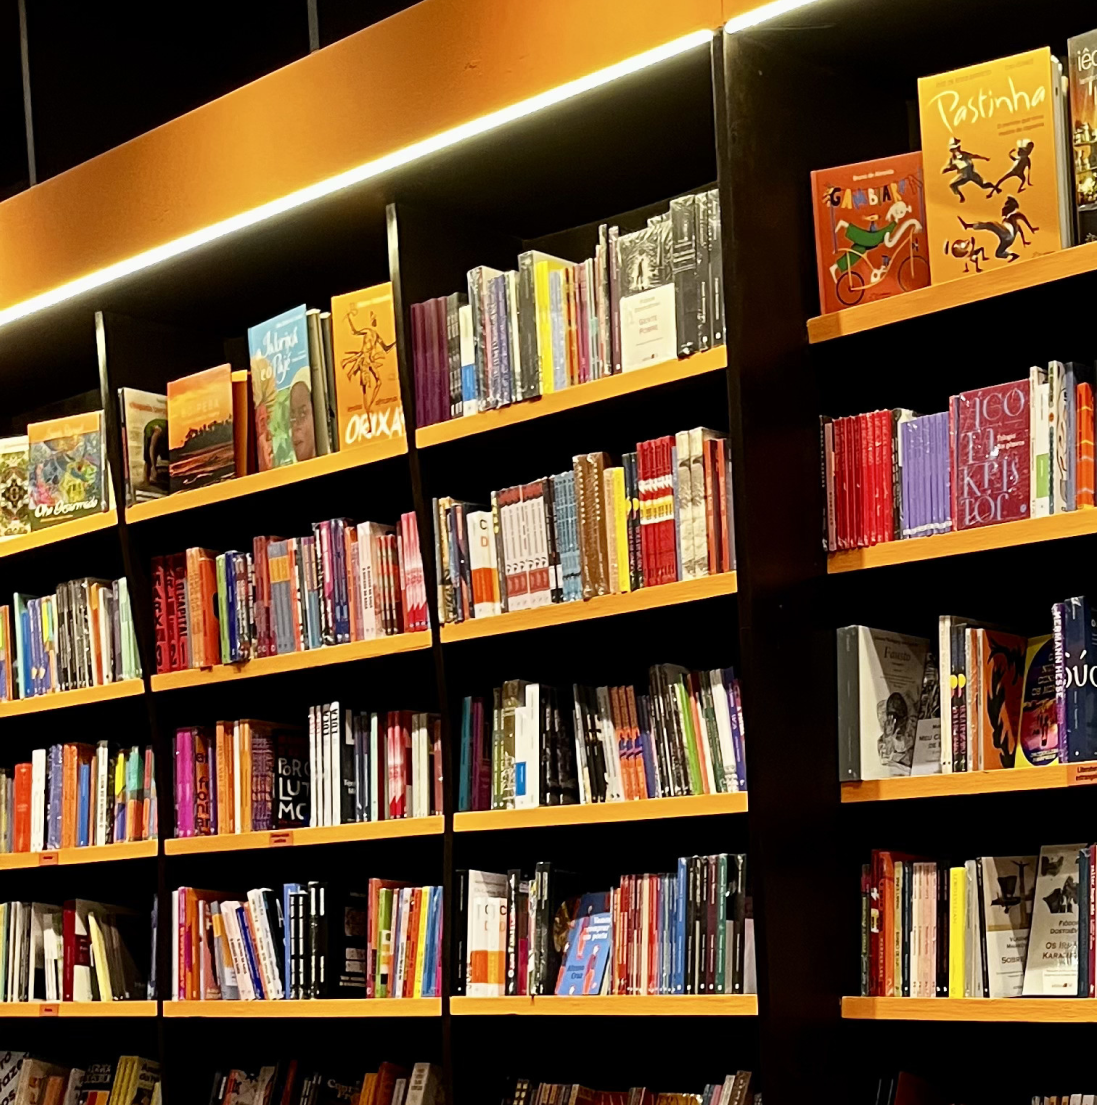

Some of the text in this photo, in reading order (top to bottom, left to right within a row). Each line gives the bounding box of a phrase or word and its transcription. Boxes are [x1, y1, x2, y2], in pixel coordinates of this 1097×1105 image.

[927, 77, 1046, 136] Pastinha
[1053, 611, 1064, 703] HERMANN HESSE
